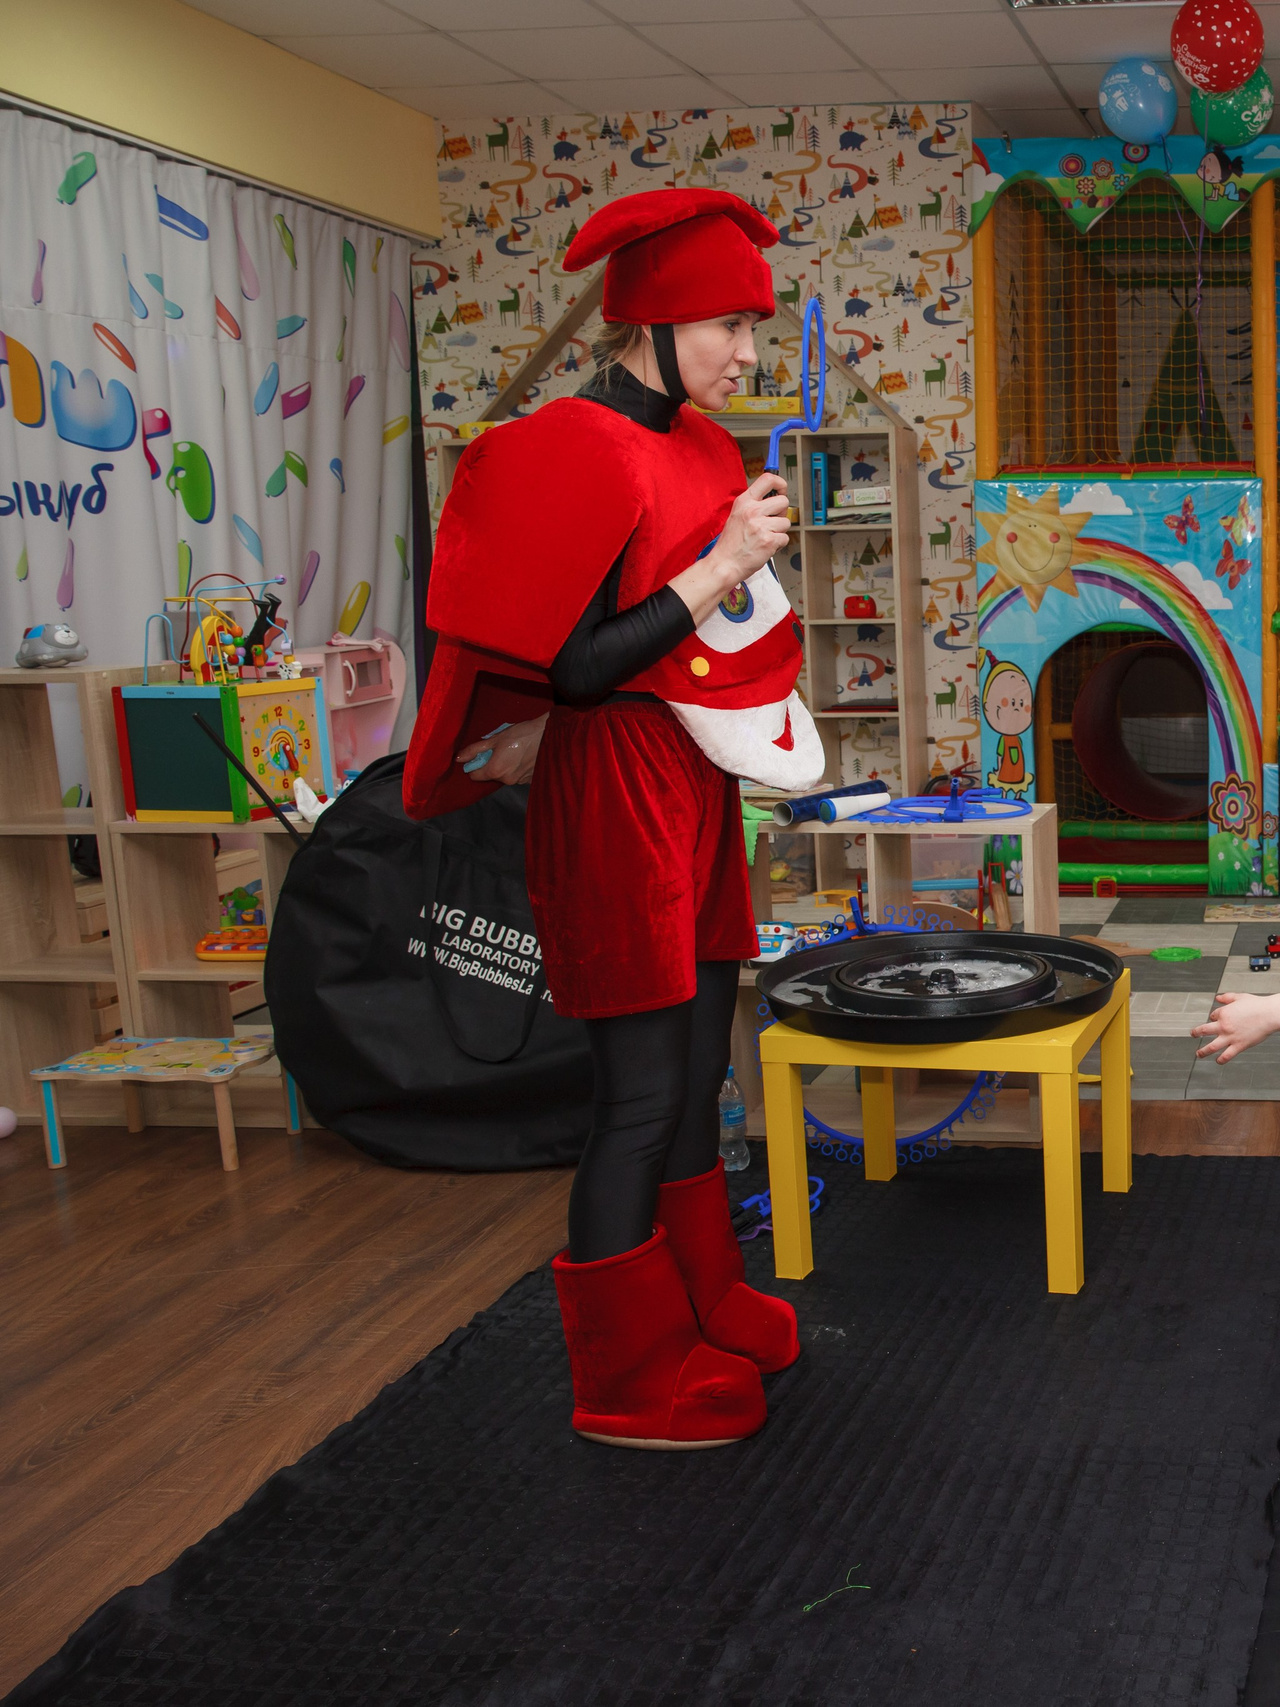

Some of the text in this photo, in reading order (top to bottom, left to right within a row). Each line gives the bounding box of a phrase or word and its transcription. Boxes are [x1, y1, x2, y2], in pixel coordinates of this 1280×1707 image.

[274, 706, 283, 717] 12
[261, 713, 269, 724] 11
[298, 720, 305, 731] 2
[303, 739, 311, 750] 3
[252, 746, 260, 757] 9
[257, 763, 265, 775] 8
[282, 778, 289, 789] 6
[441, 932, 541, 977] LABORATORY
[407, 937, 554, 1003] WW.BigBubblesLa.ru
